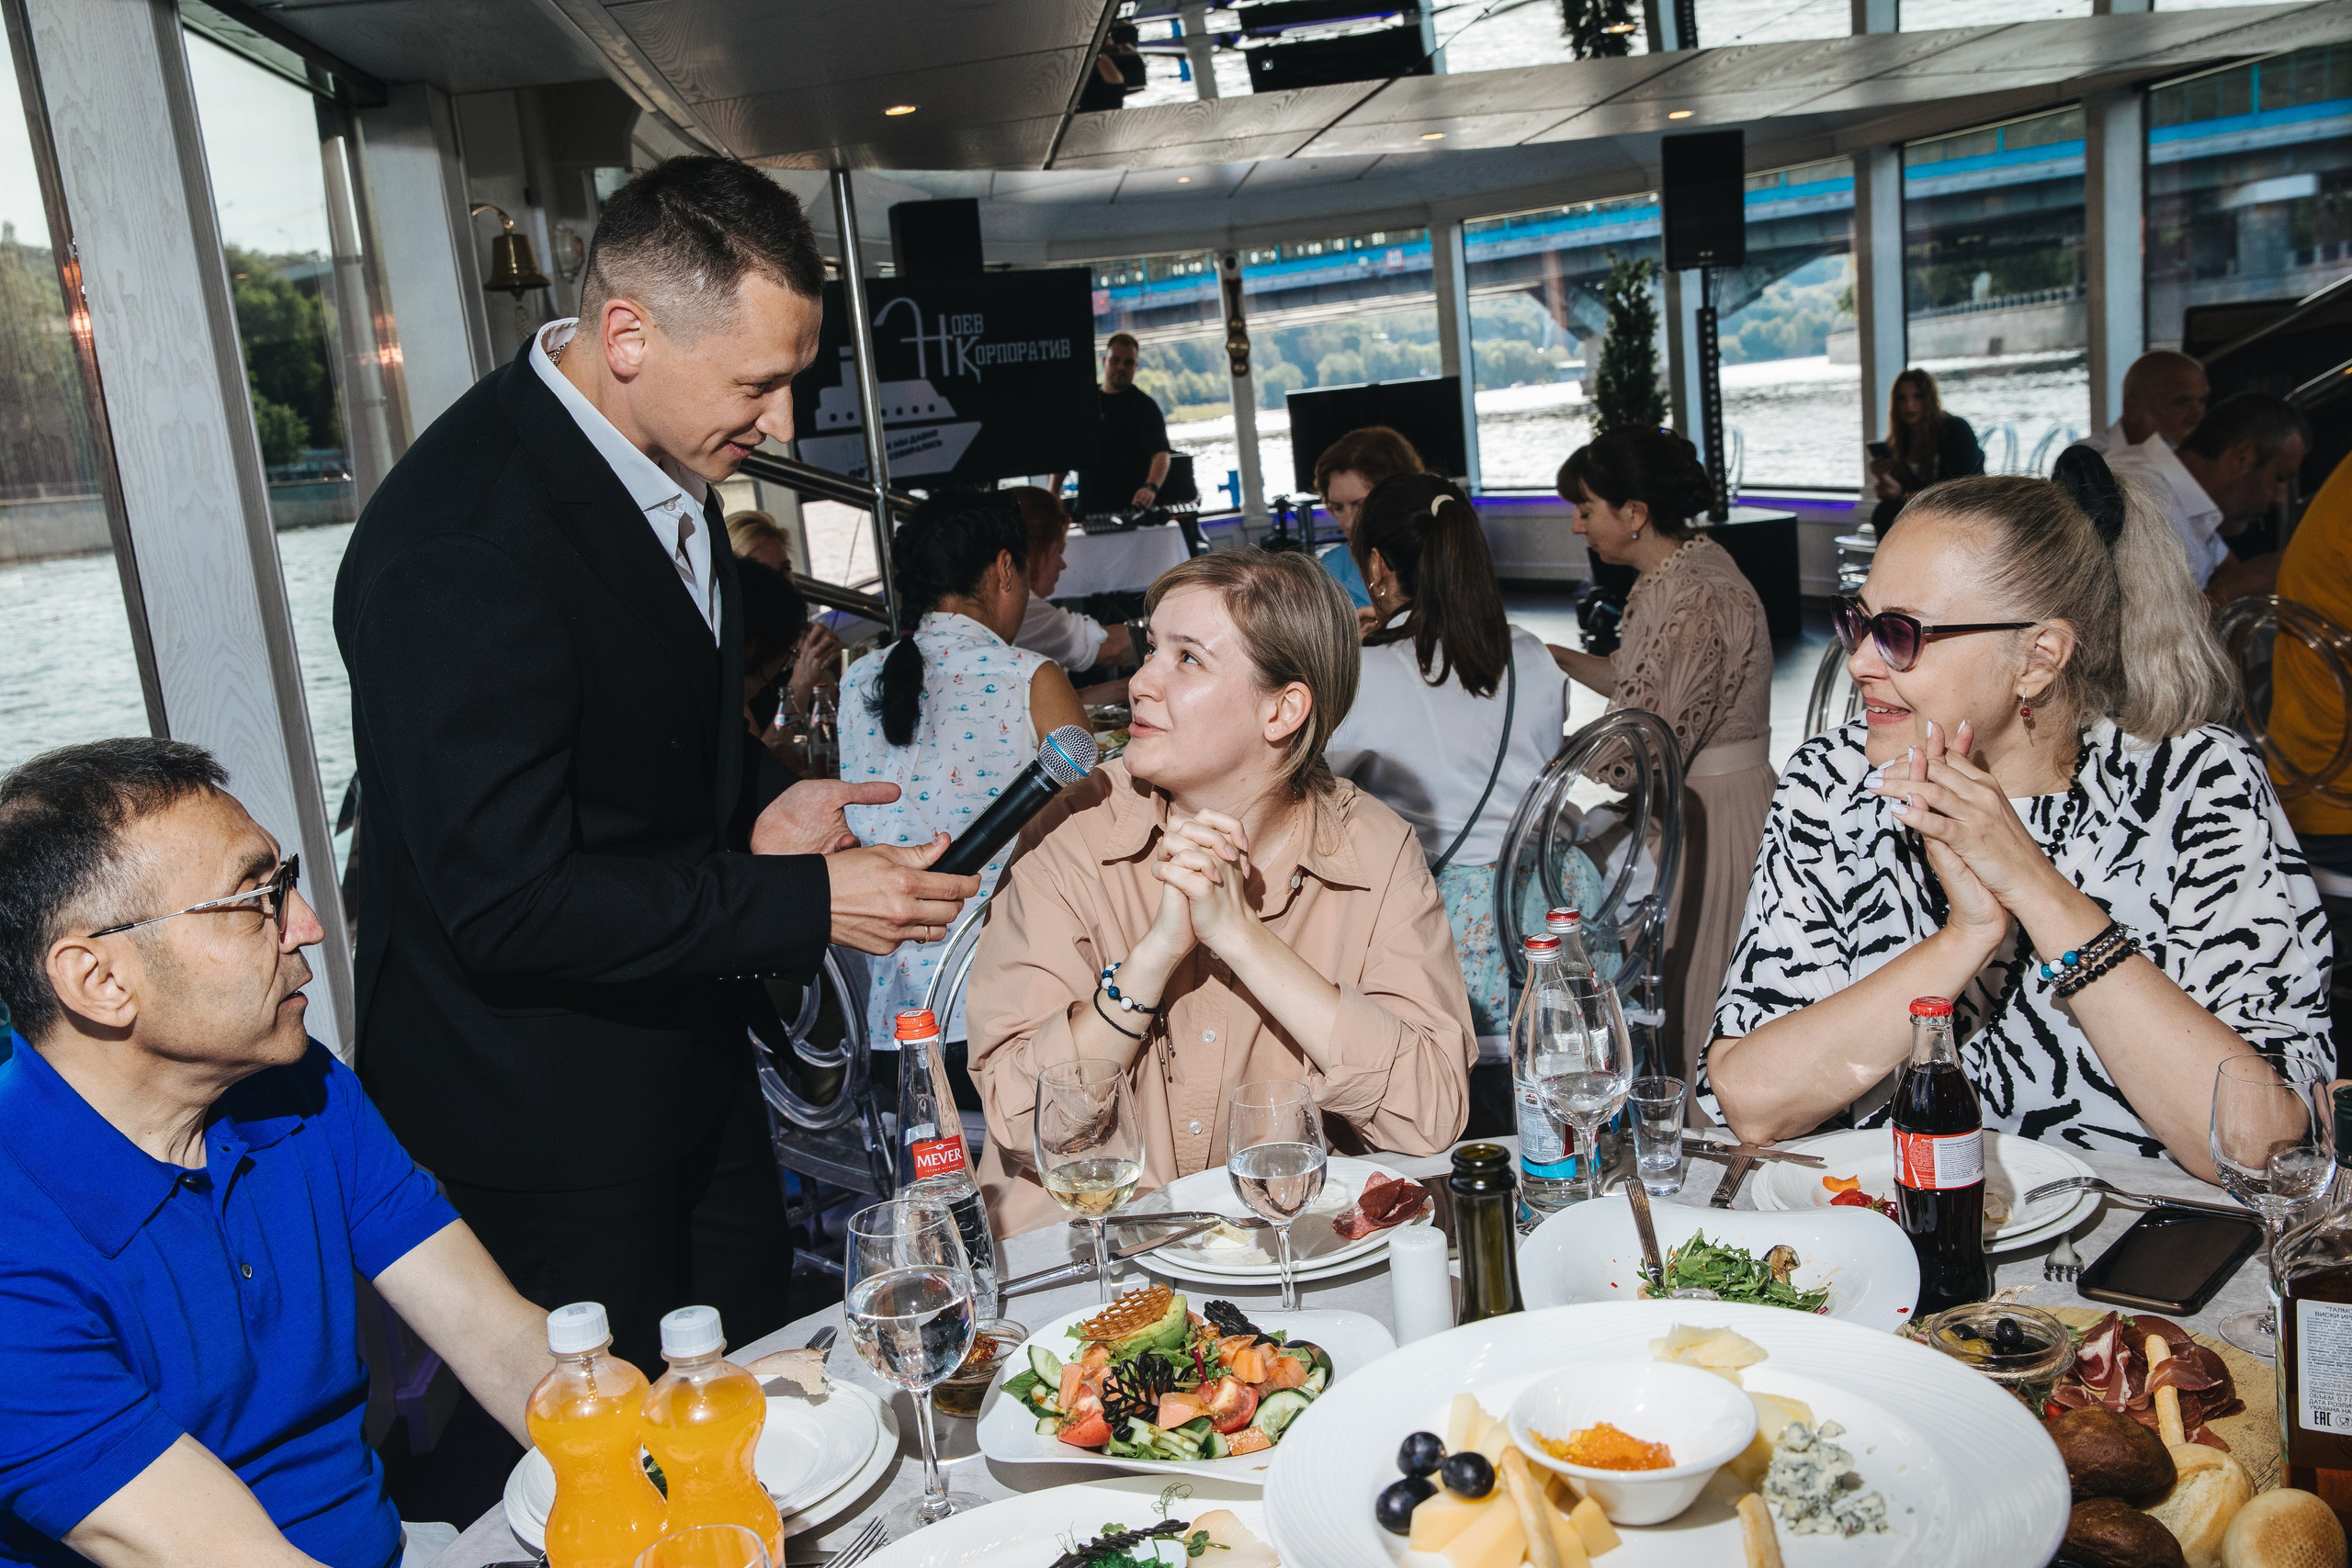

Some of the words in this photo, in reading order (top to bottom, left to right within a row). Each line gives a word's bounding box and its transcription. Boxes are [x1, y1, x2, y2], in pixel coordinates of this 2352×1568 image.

[956, 335, 1071, 384] КОРПОРАТИВ
[917, 1147, 963, 1168] MEVER
[2314, 1311, 2340, 1319] ВИСКИ
[2309, 1404, 2340, 1414] УКАЗАНА
